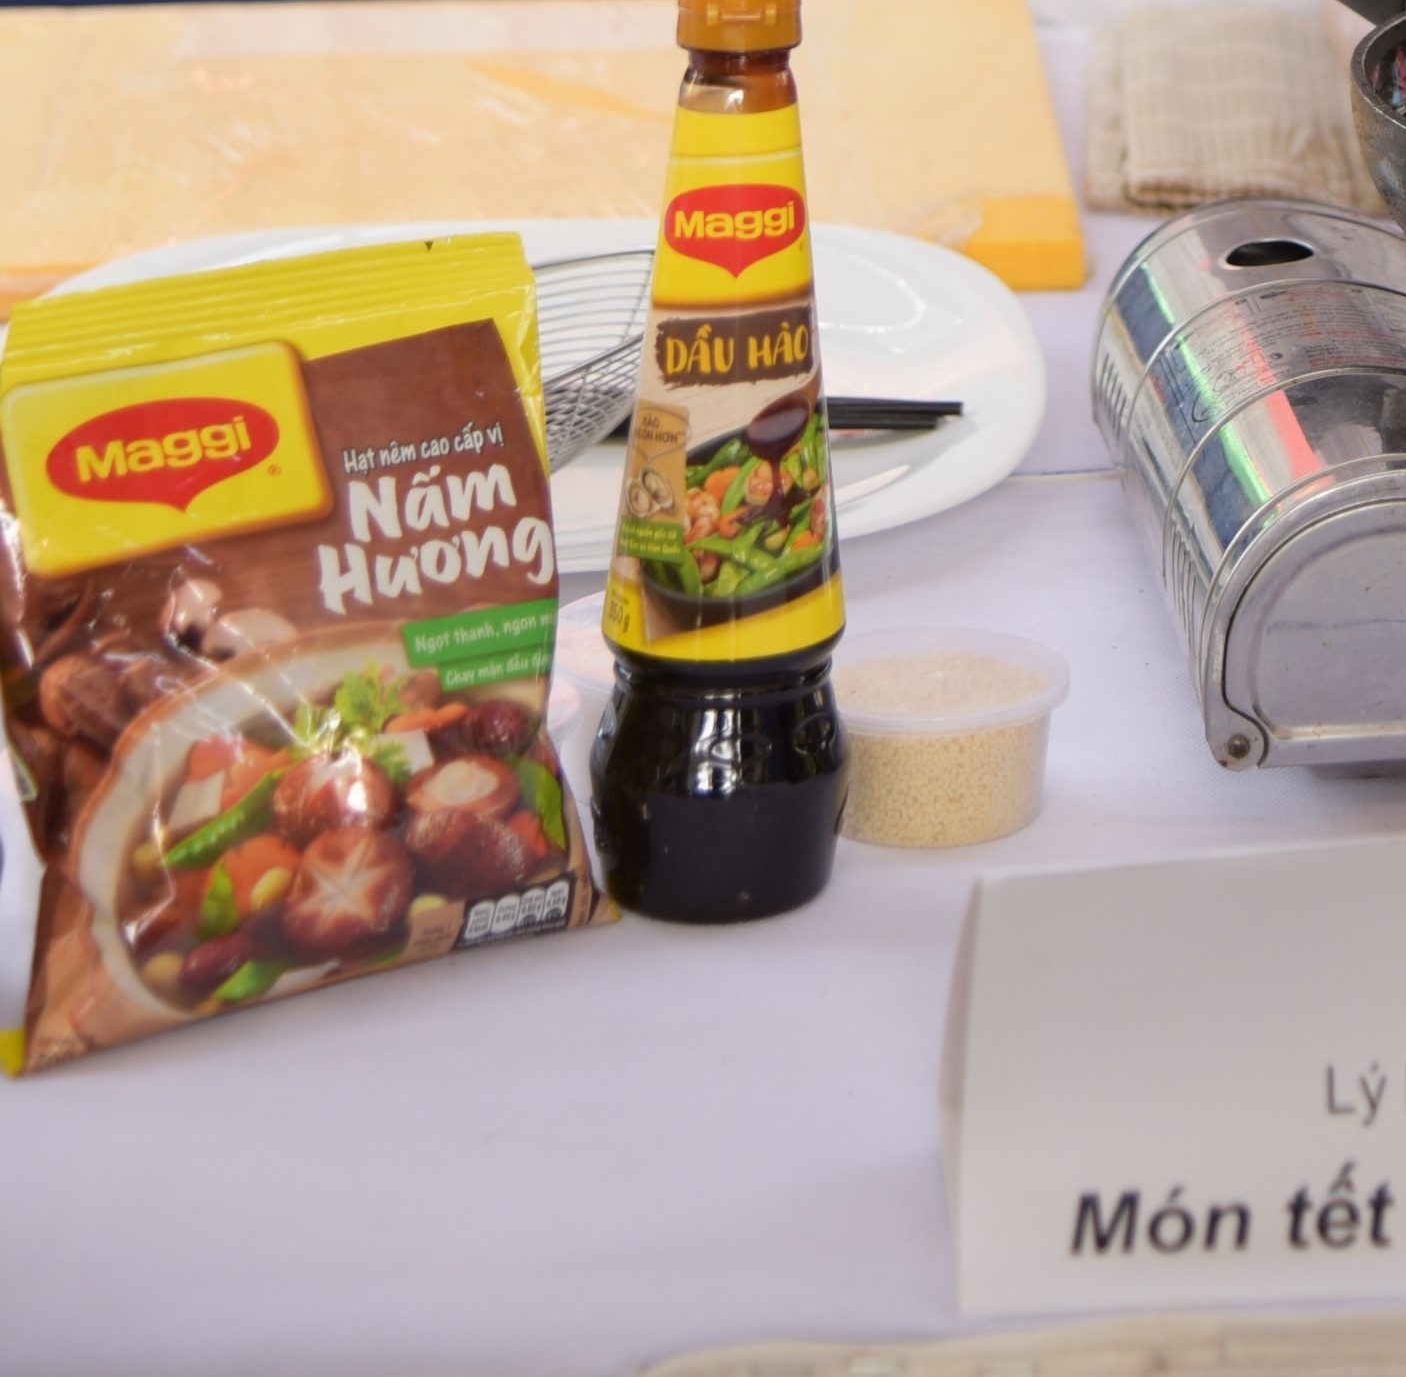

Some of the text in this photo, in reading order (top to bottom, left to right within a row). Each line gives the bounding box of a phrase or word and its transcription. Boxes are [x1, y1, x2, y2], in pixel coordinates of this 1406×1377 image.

[675, 200, 795, 240] Maggi
[665, 324, 735, 375] DẦU
[76, 415, 251, 483] Maggi
[343, 421, 505, 475] Hạt nêm cao cấp vị
[348, 464, 517, 544] Nấm
[318, 516, 554, 615] Hương
[502, 615, 537, 637] ngon
[1326, 1060, 1387, 1128] Lý
[1070, 1183, 1252, 1256] Món
[1286, 1160, 1394, 1250] tết
